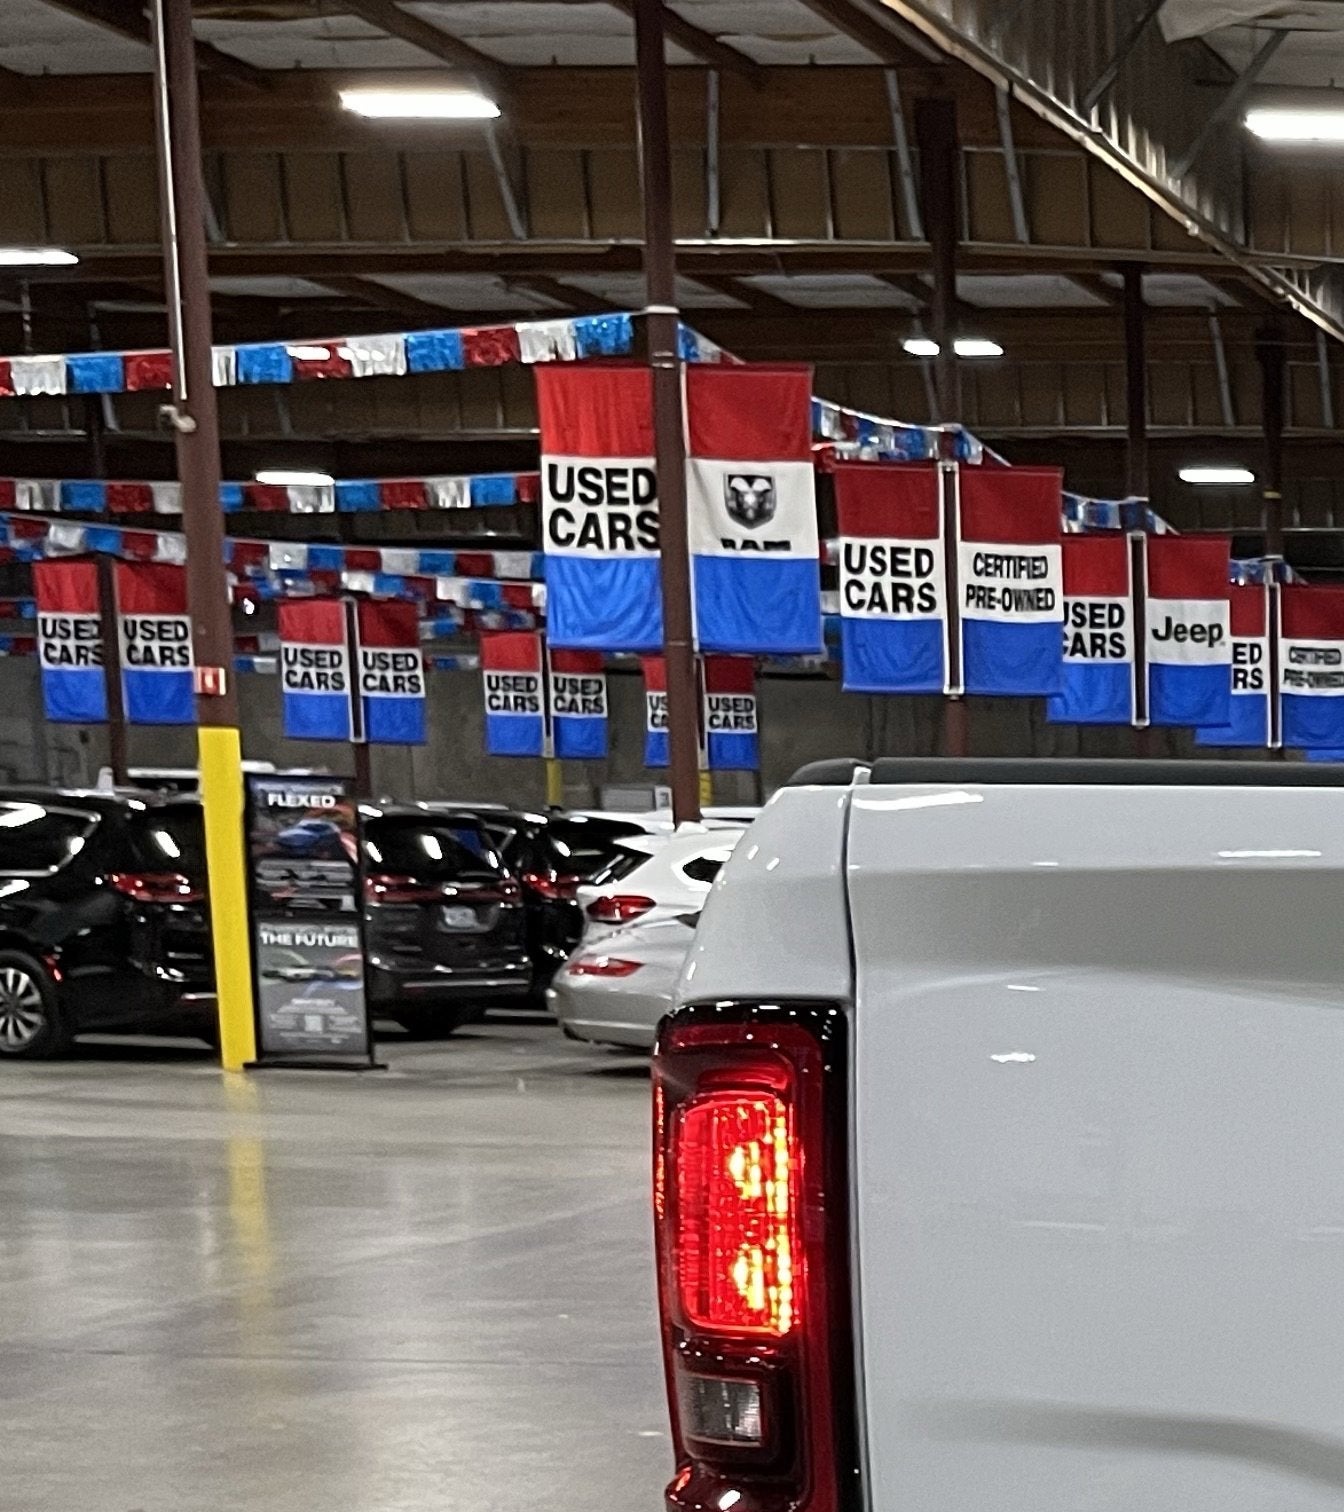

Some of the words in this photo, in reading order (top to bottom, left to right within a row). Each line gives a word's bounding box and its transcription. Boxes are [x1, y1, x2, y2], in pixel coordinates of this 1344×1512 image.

[547, 463, 657, 506] USED
[548, 507, 660, 551] CARS
[844, 543, 935, 579] USED
[973, 551, 1048, 580] CERTIFIED
[844, 579, 938, 614] CARS
[965, 583, 1056, 612] PRE-OWNED
[123, 619, 189, 642] USED
[1151, 615, 1224, 648] Jeep
[126, 644, 190, 667] CARS
[1063, 631, 1127, 659] ARS
[1231, 642, 1263, 665] ED
[283, 646, 343, 669] USED
[362, 650, 419, 672] USED
[284, 668, 346, 692] CARS
[362, 671, 421, 694] CARS
[486, 674, 538, 694] USED
[552, 675, 604, 695] USED
[1232, 667, 1264, 690] RS
[487, 693, 541, 713] CARS
[553, 694, 605, 714] CARS
[707, 696, 755, 713] USED
[708, 714, 755, 730] CARS
[268, 792, 336, 809] FLEXED
[260, 931, 293, 946] THE
